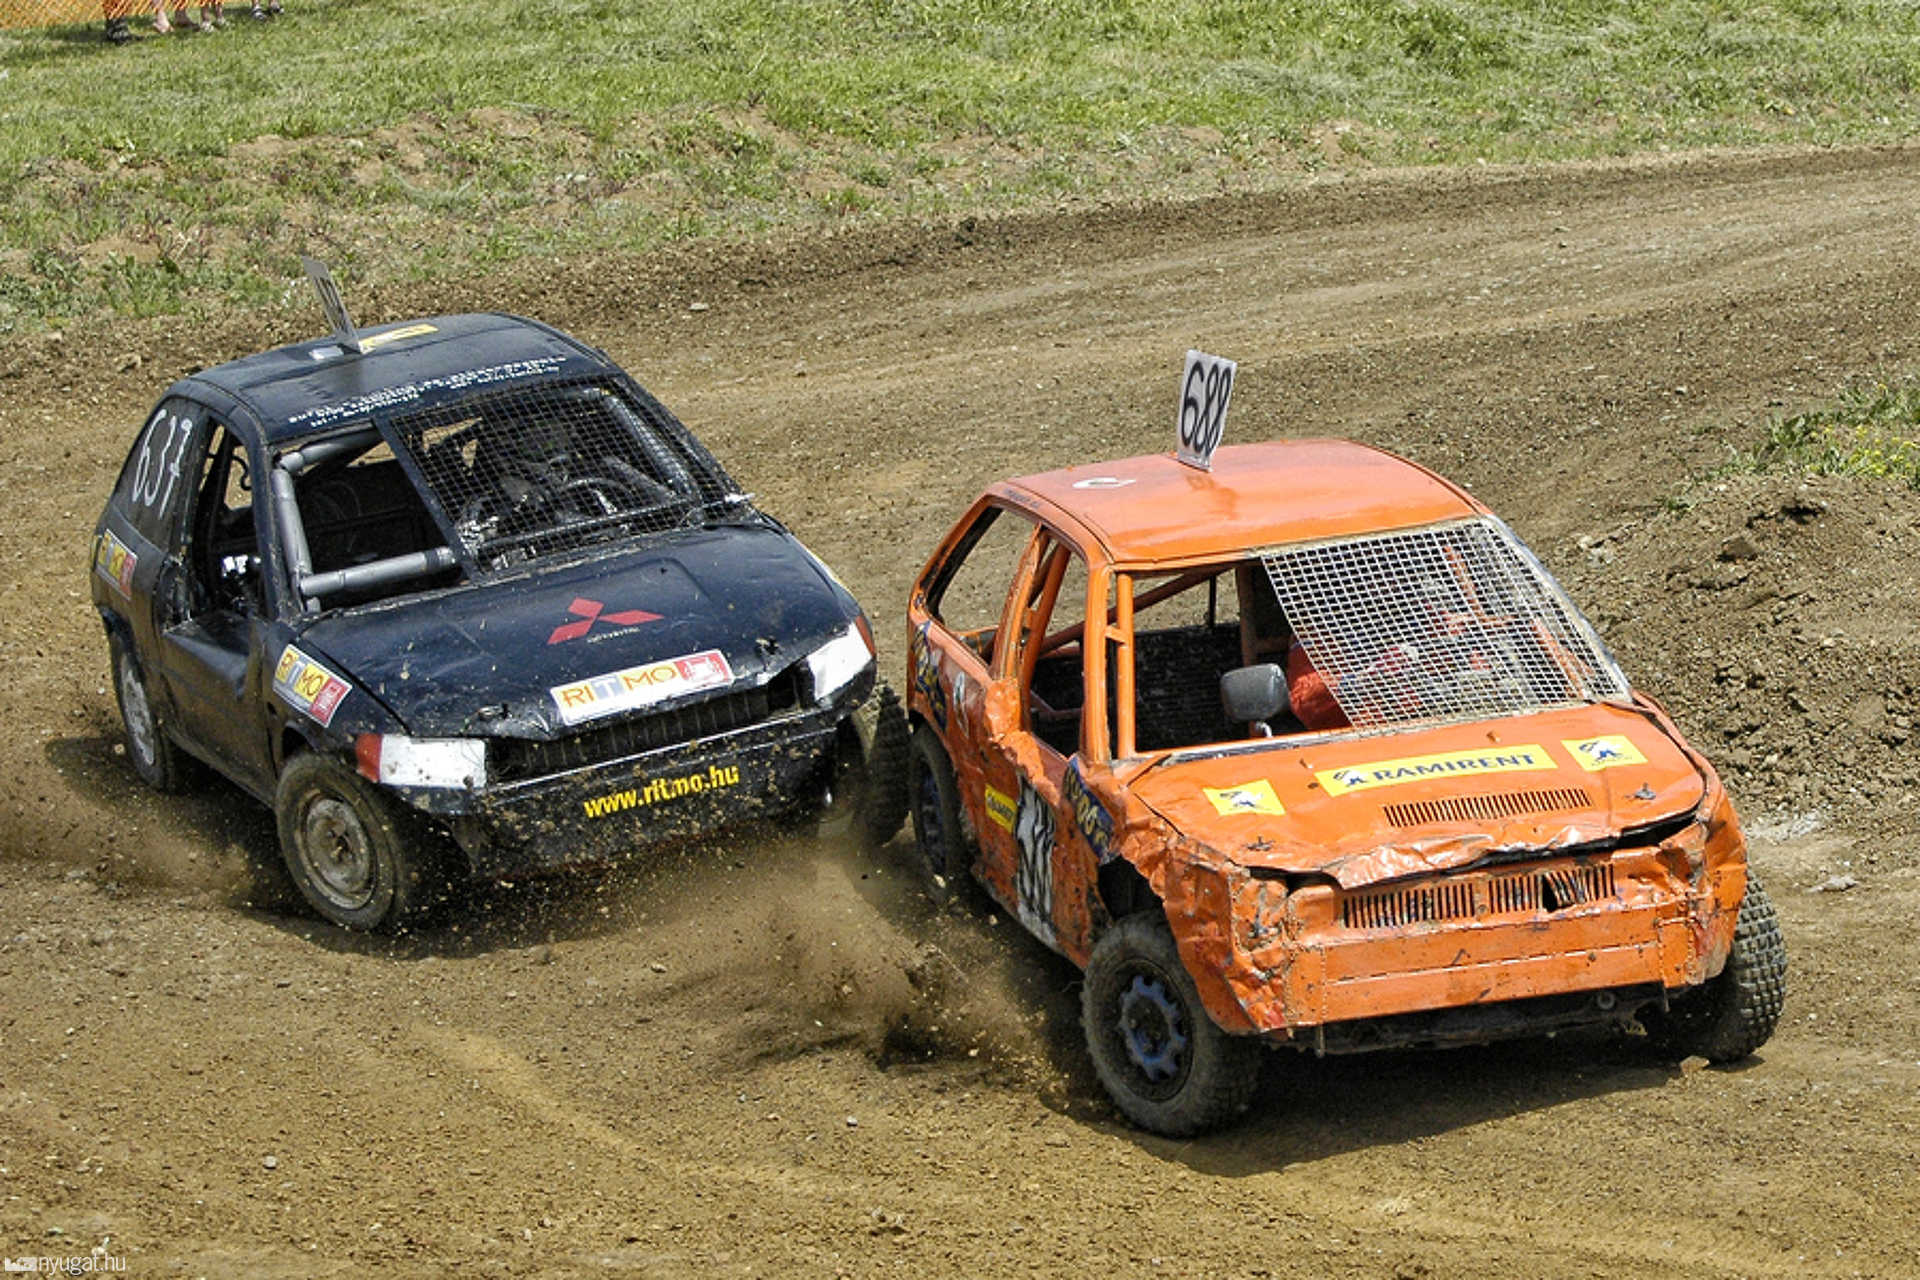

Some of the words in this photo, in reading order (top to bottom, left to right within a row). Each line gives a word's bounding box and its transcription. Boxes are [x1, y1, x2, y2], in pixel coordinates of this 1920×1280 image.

[1181, 361, 1232, 456] 688
[562, 665, 678, 707] RITMO
[1372, 752, 1536, 783] RAMIRENT
